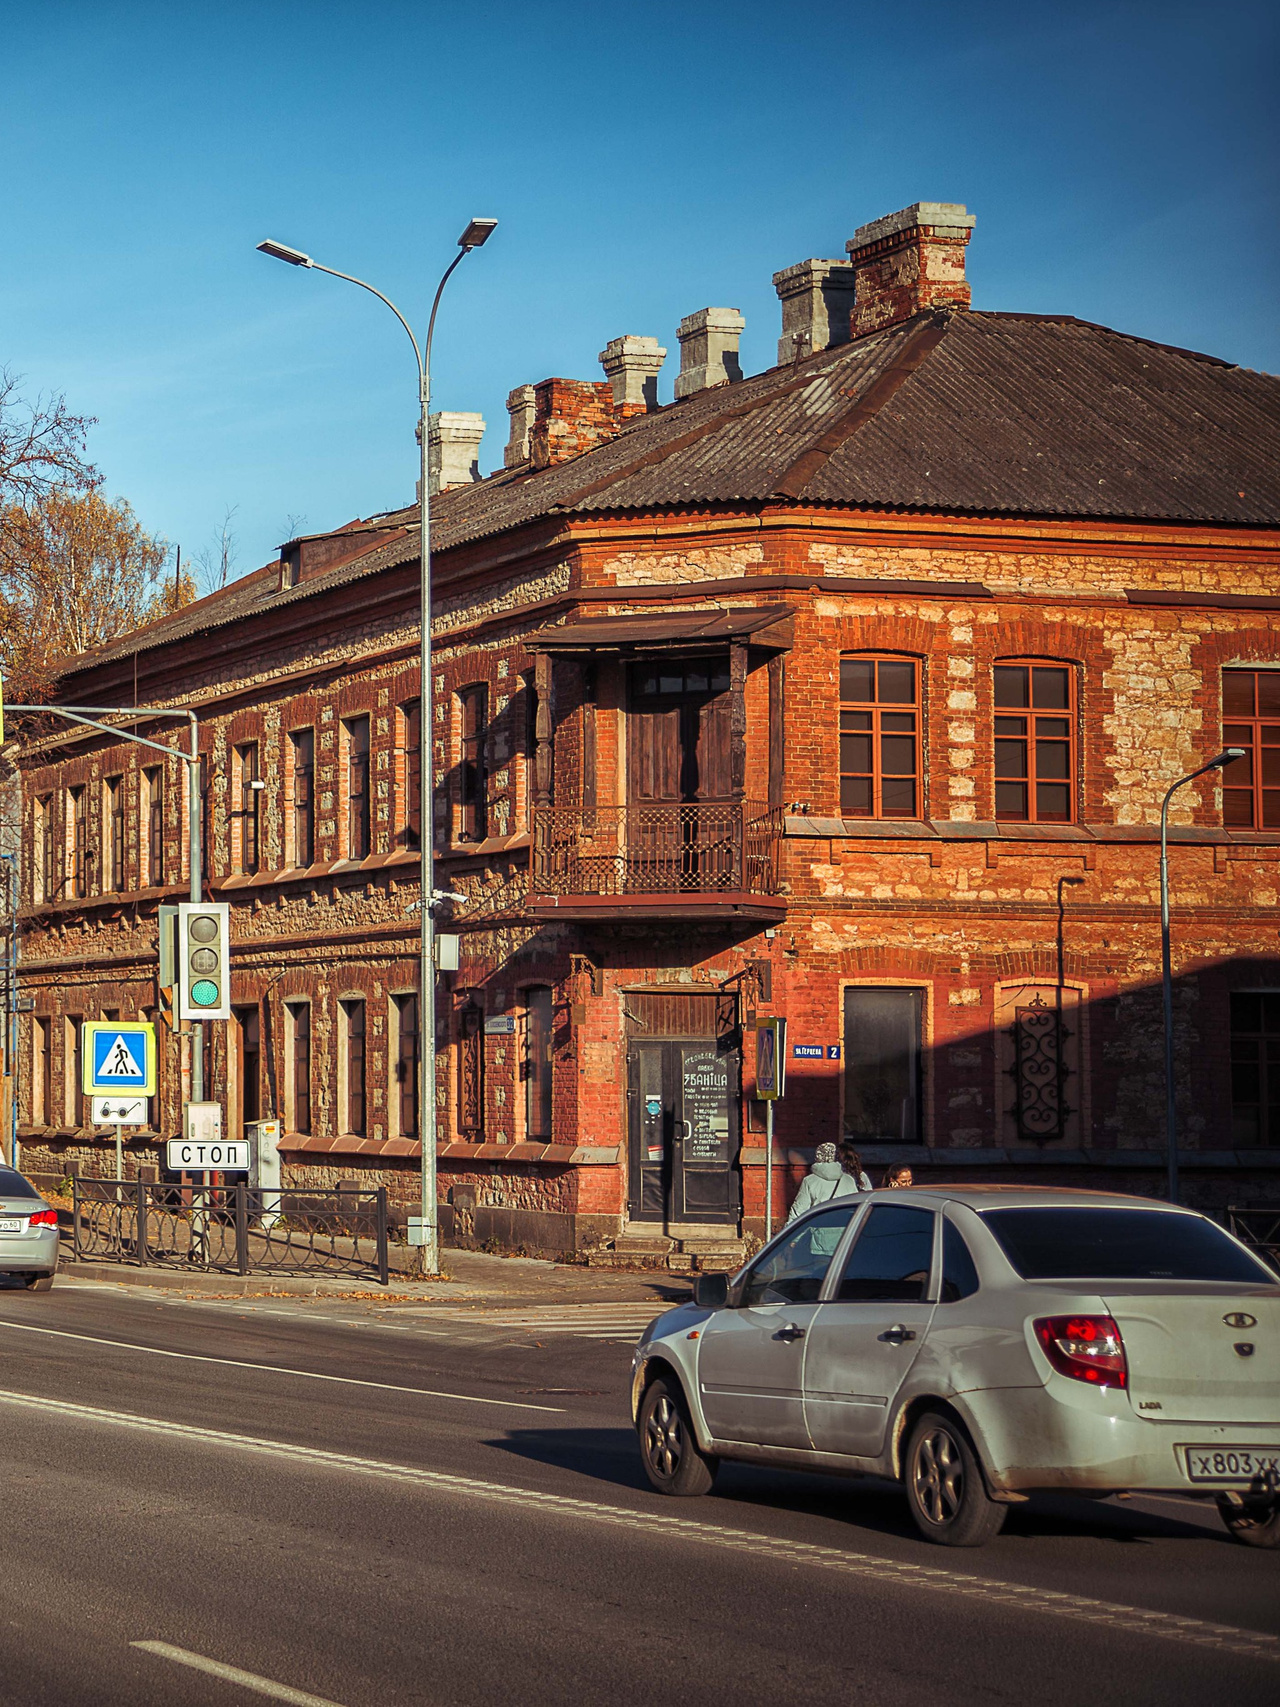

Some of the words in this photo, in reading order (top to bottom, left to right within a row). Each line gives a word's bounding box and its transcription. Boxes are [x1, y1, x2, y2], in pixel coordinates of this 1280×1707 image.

[830, 1047, 838, 1058] 2
[181, 1146, 237, 1164] СТОП
[1139, 1401, 1162, 1410] LADA
